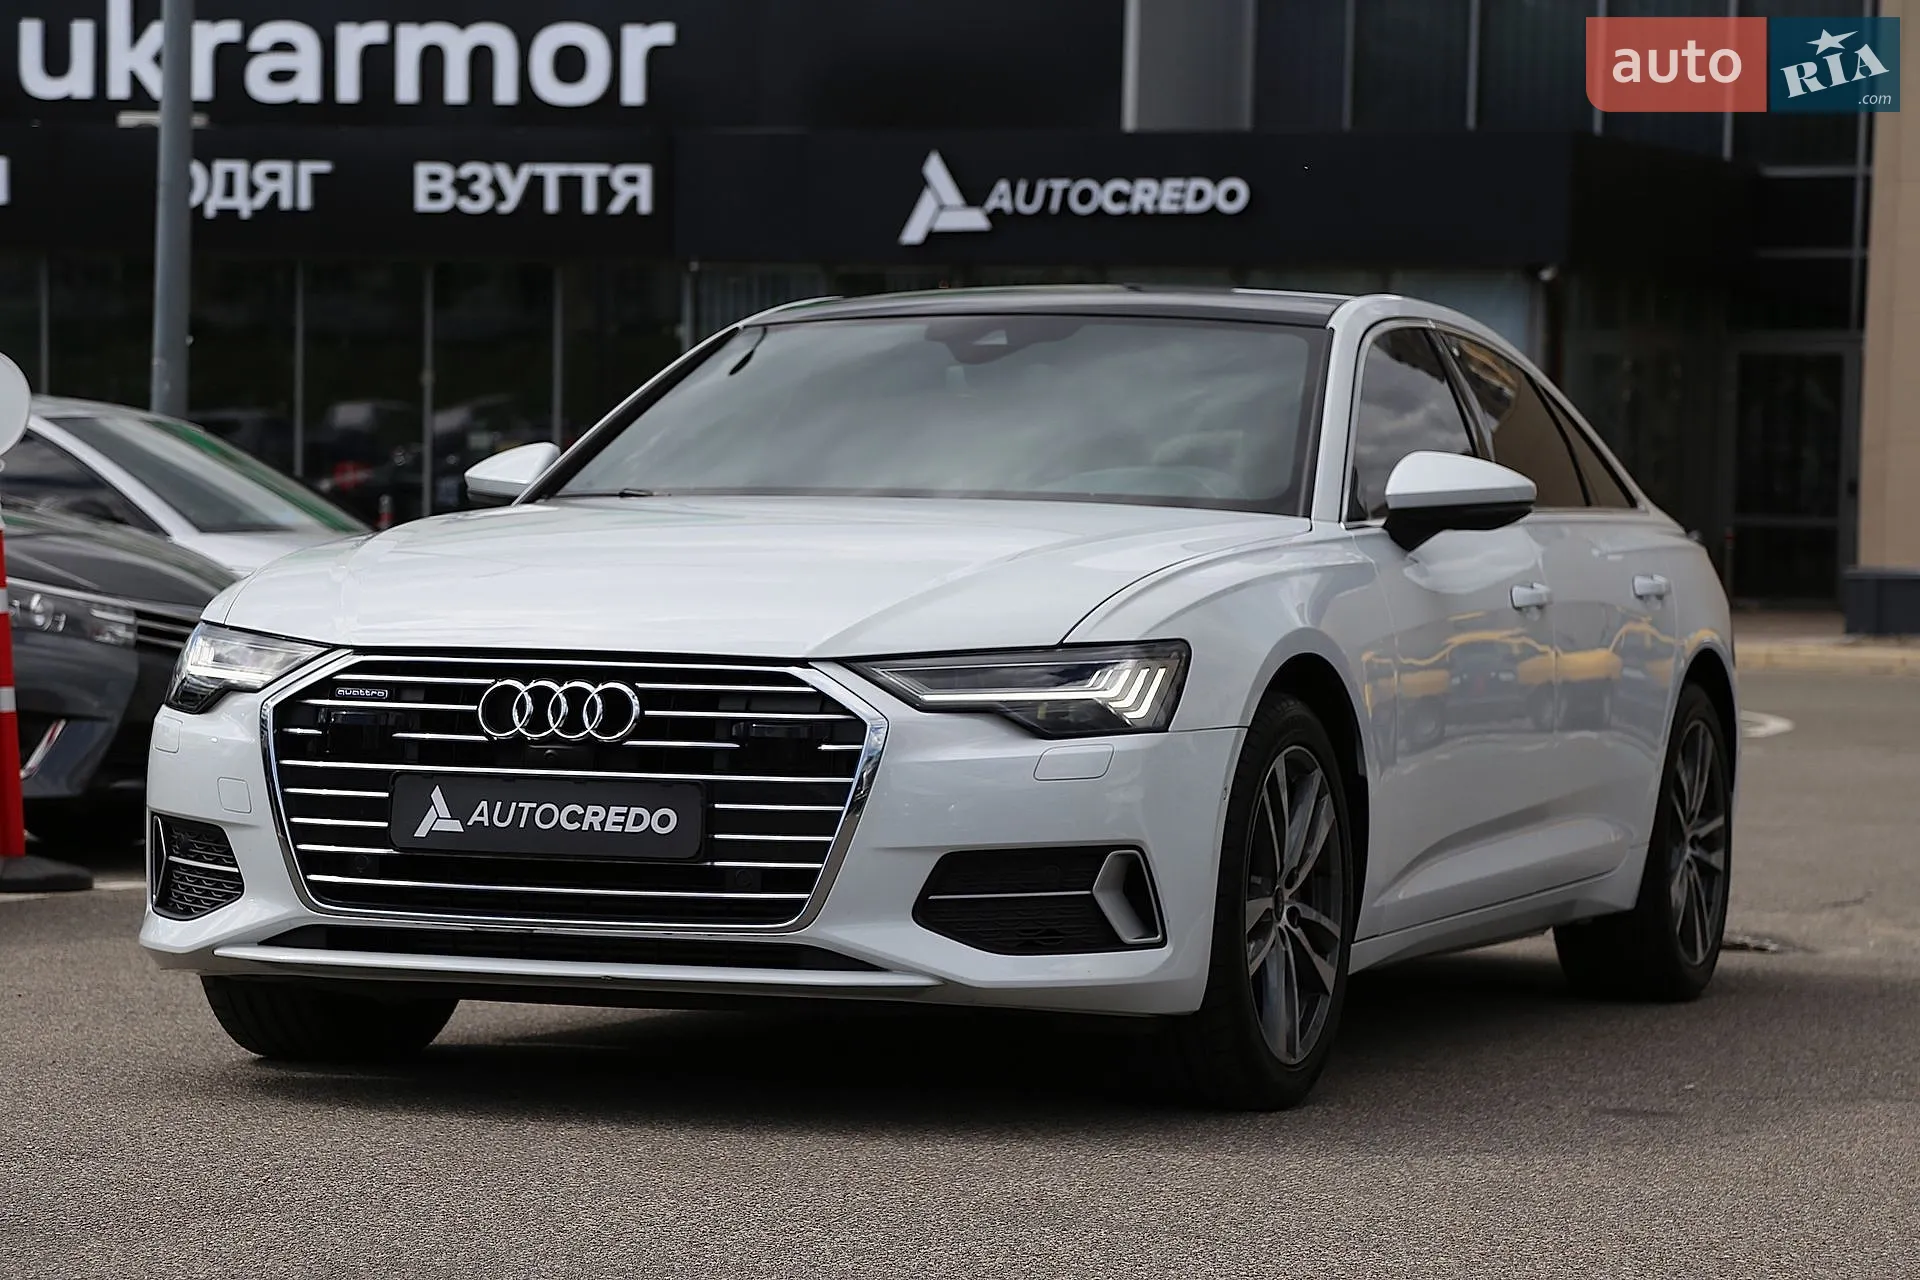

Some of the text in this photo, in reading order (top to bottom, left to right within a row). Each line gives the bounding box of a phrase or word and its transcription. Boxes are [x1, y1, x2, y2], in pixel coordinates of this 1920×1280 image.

[18, 0, 676, 106] ukrarmor
[413, 161, 654, 215] ВЗУТТЯ
[983, 176, 1251, 216] AUTOCREDO
[336, 688, 386, 698] quattro
[466, 800, 678, 835] AUTOCREDO
